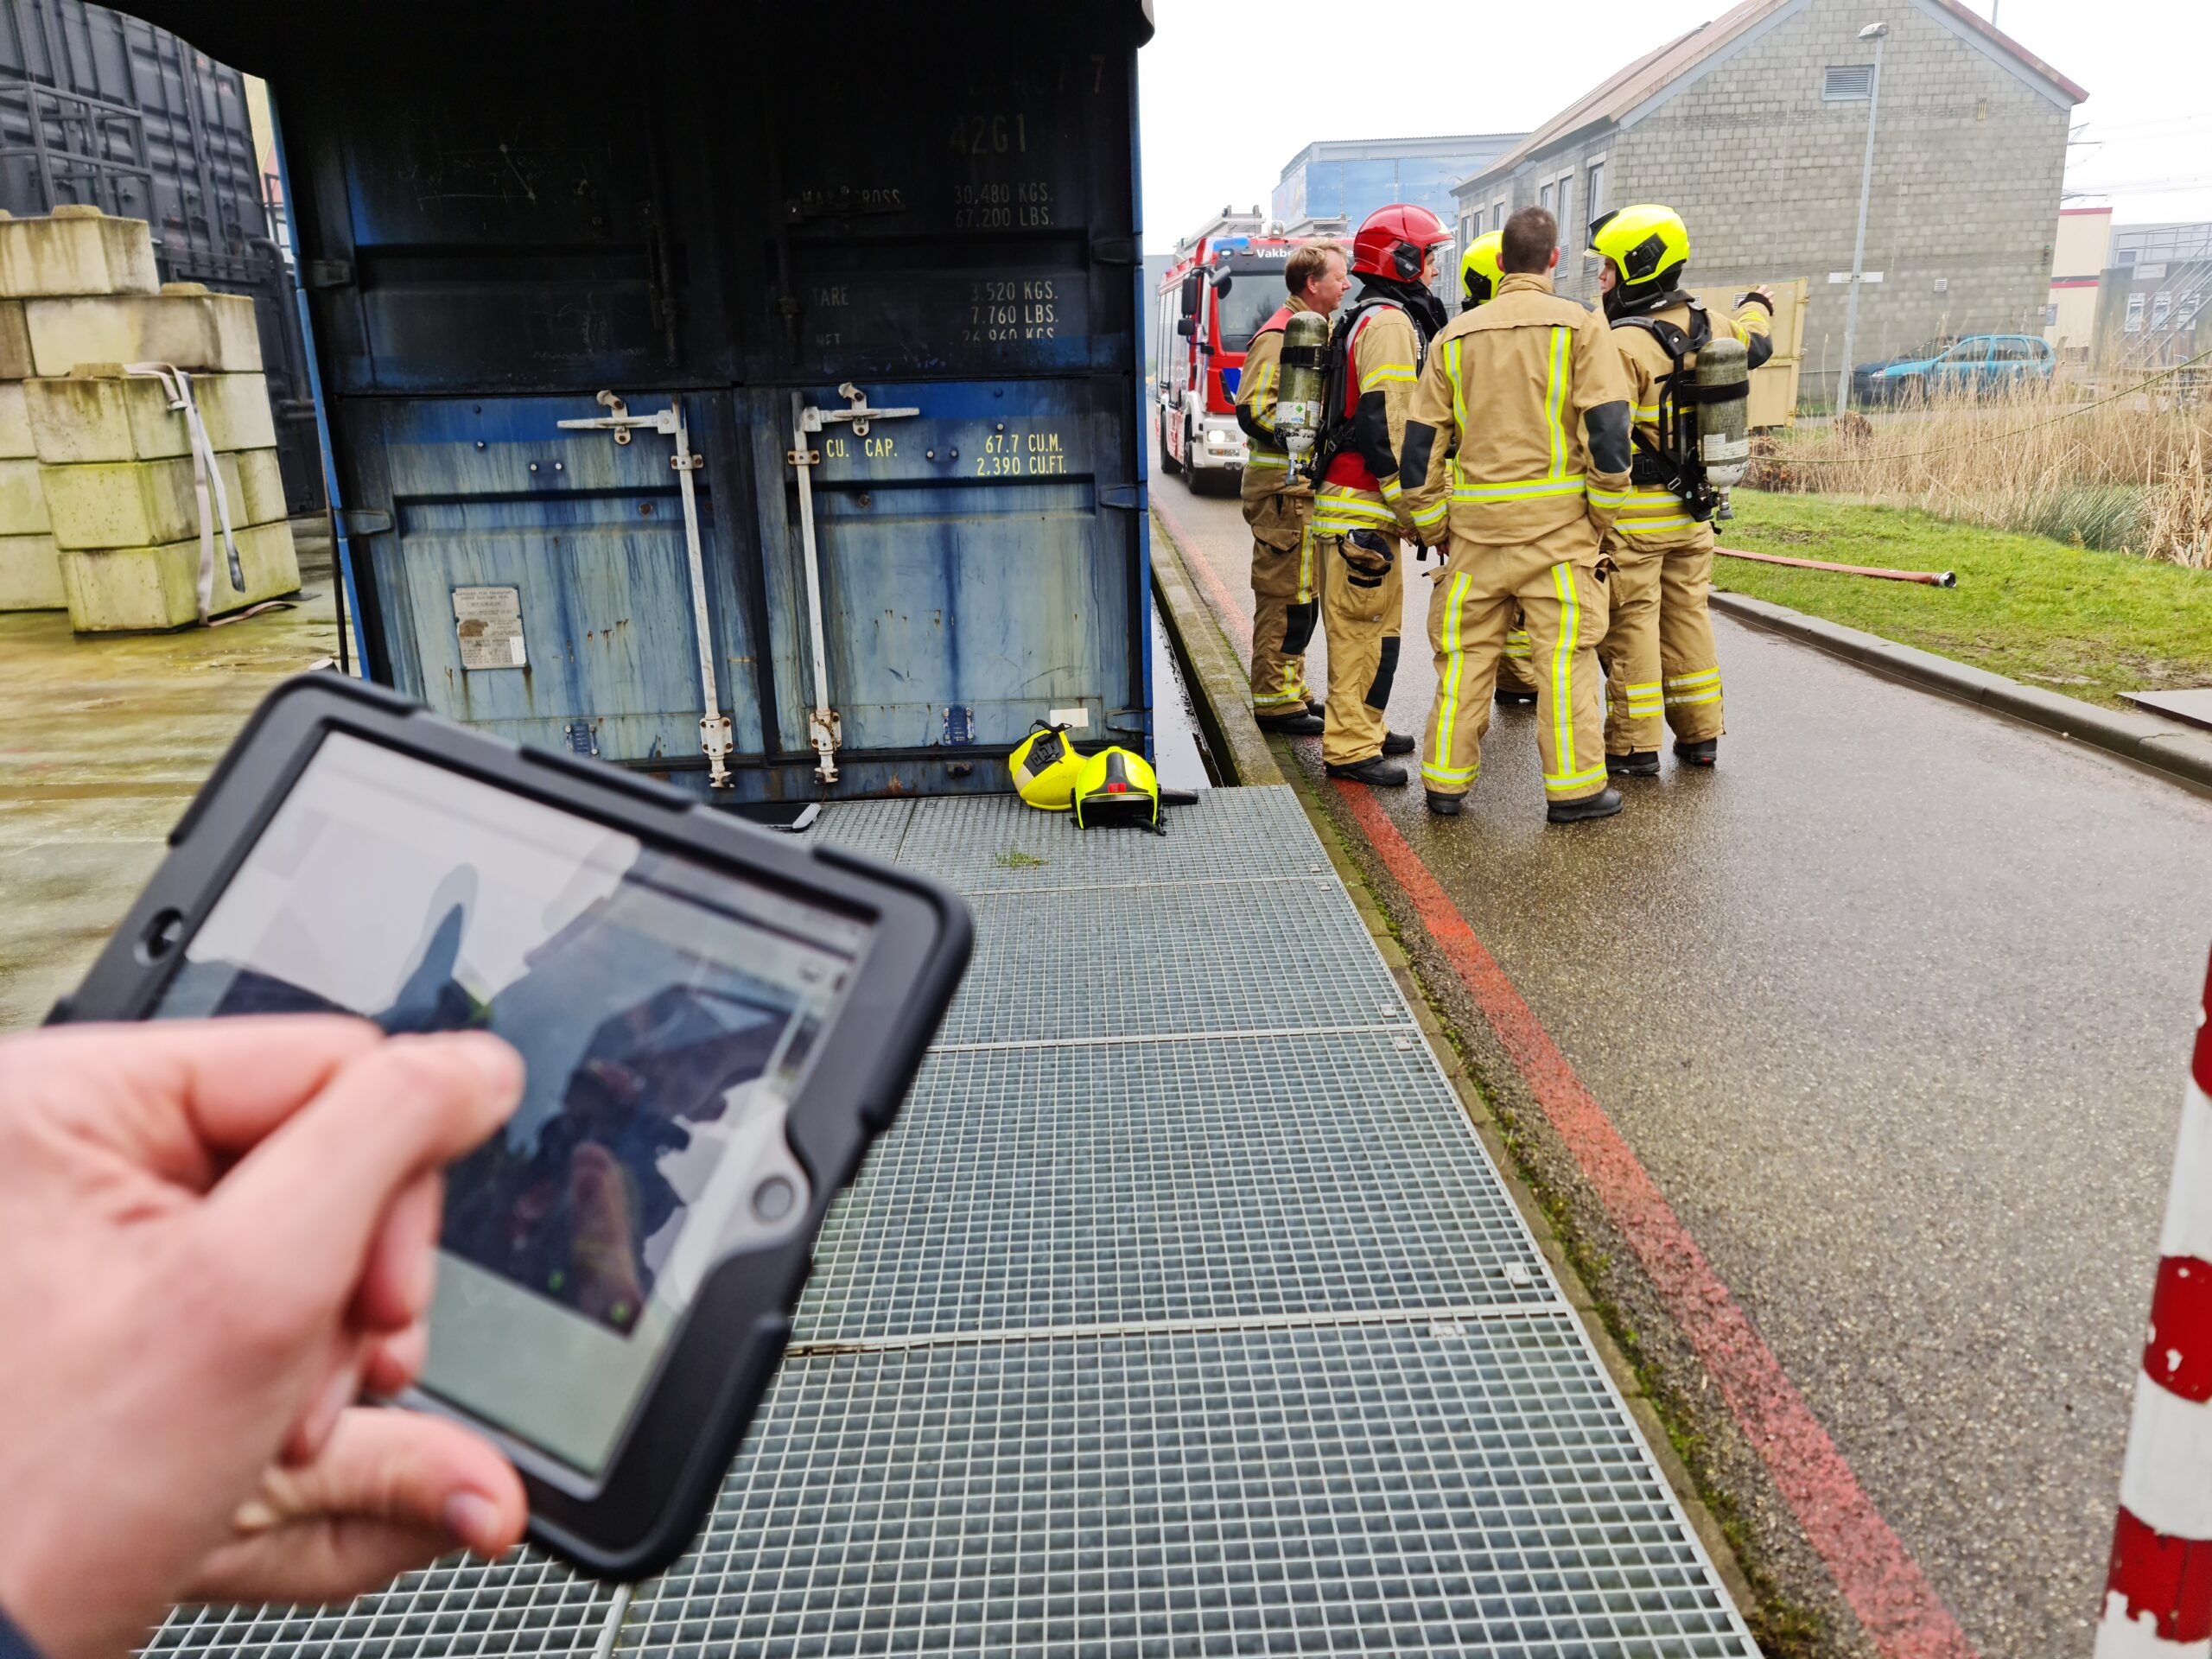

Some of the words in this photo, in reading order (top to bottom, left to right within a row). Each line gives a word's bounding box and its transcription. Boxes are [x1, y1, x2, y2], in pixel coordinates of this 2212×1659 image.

[949, 113, 1027, 154] 42G1
[854, 188, 901, 205] ROSS
[1019, 206, 1054, 226] LBS.
[810, 286, 849, 307] TARE
[1023, 280, 1058, 301] KGS.
[970, 305, 1016, 325] 7.760
[1025, 303, 1059, 323] LBS.
[825, 439, 849, 459] CU.
[864, 437, 898, 458] CAP.
[985, 435, 1020, 454] 67.7
[1028, 433, 1063, 453] CU.M.
[976, 456, 1020, 476] 2,390
[1029, 455, 1067, 474] CU.FT.
